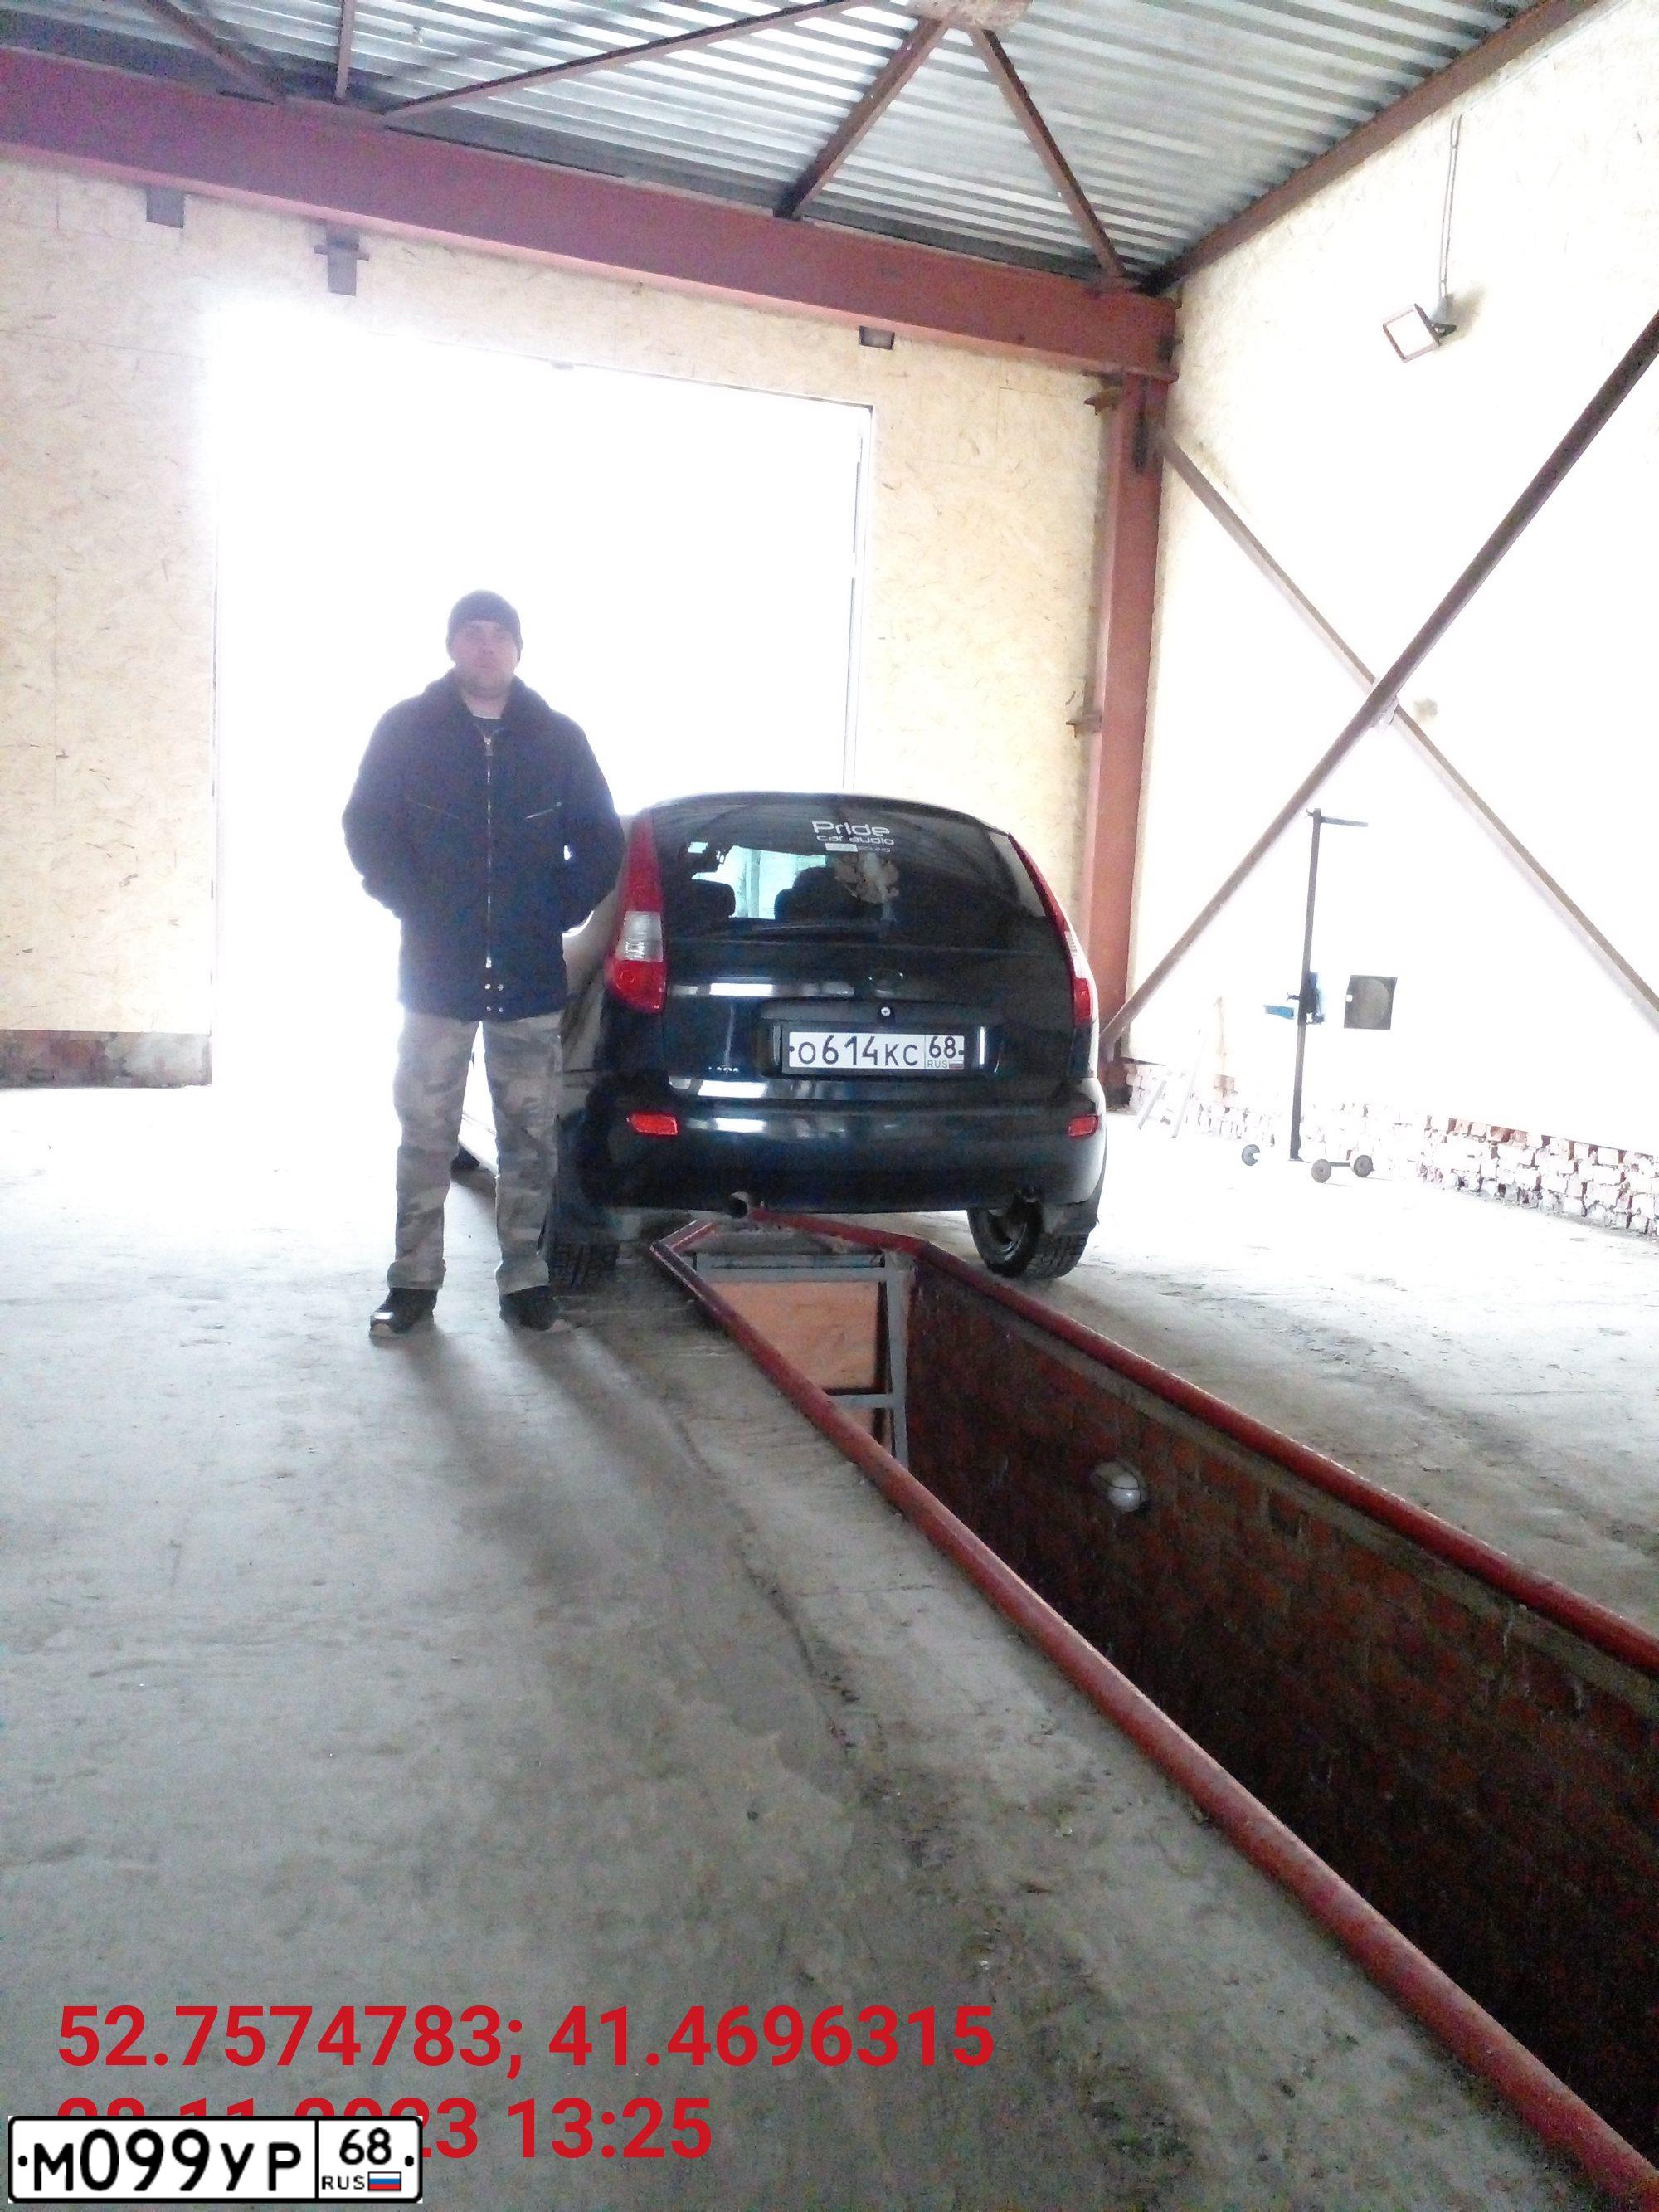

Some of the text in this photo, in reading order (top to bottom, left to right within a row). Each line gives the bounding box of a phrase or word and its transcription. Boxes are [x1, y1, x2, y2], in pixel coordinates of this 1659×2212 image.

[812, 821, 890, 837] Pride
[849, 836, 895, 845] audio
[928, 1035, 956, 1059] 68
[927, 1060, 948, 1069] RUS
